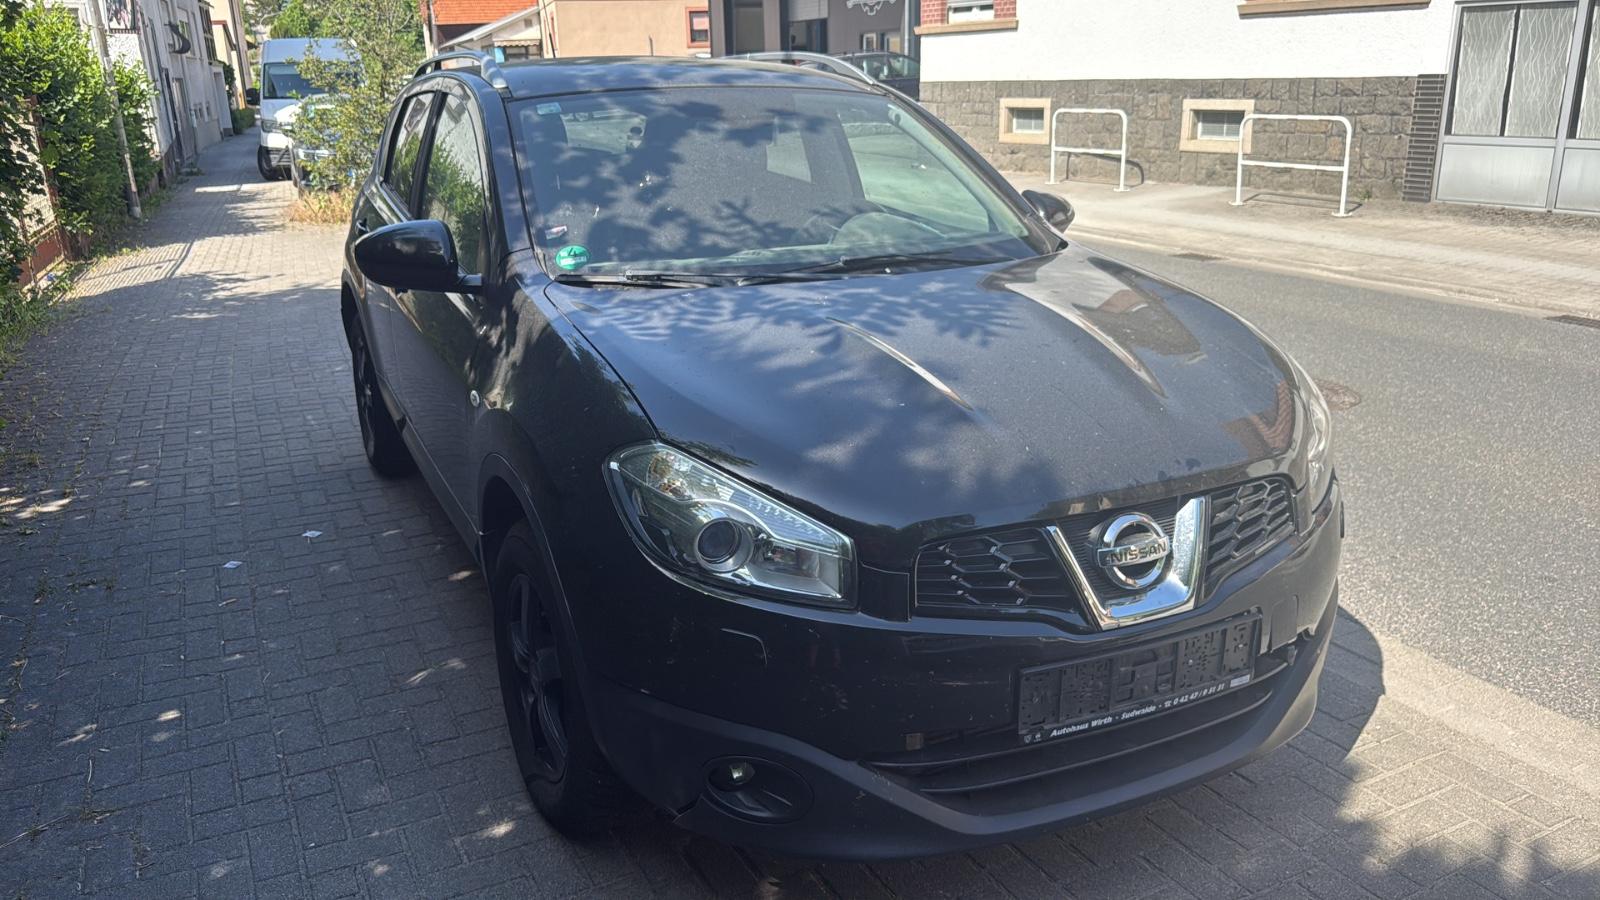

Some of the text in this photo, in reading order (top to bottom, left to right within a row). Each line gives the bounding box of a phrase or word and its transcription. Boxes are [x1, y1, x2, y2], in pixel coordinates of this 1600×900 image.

[567, 247, 577, 257] 4
[1110, 541, 1167, 562] NISSAN
[1049, 722, 1089, 738] Autohaus
[1091, 716, 1113, 727] Wirth
